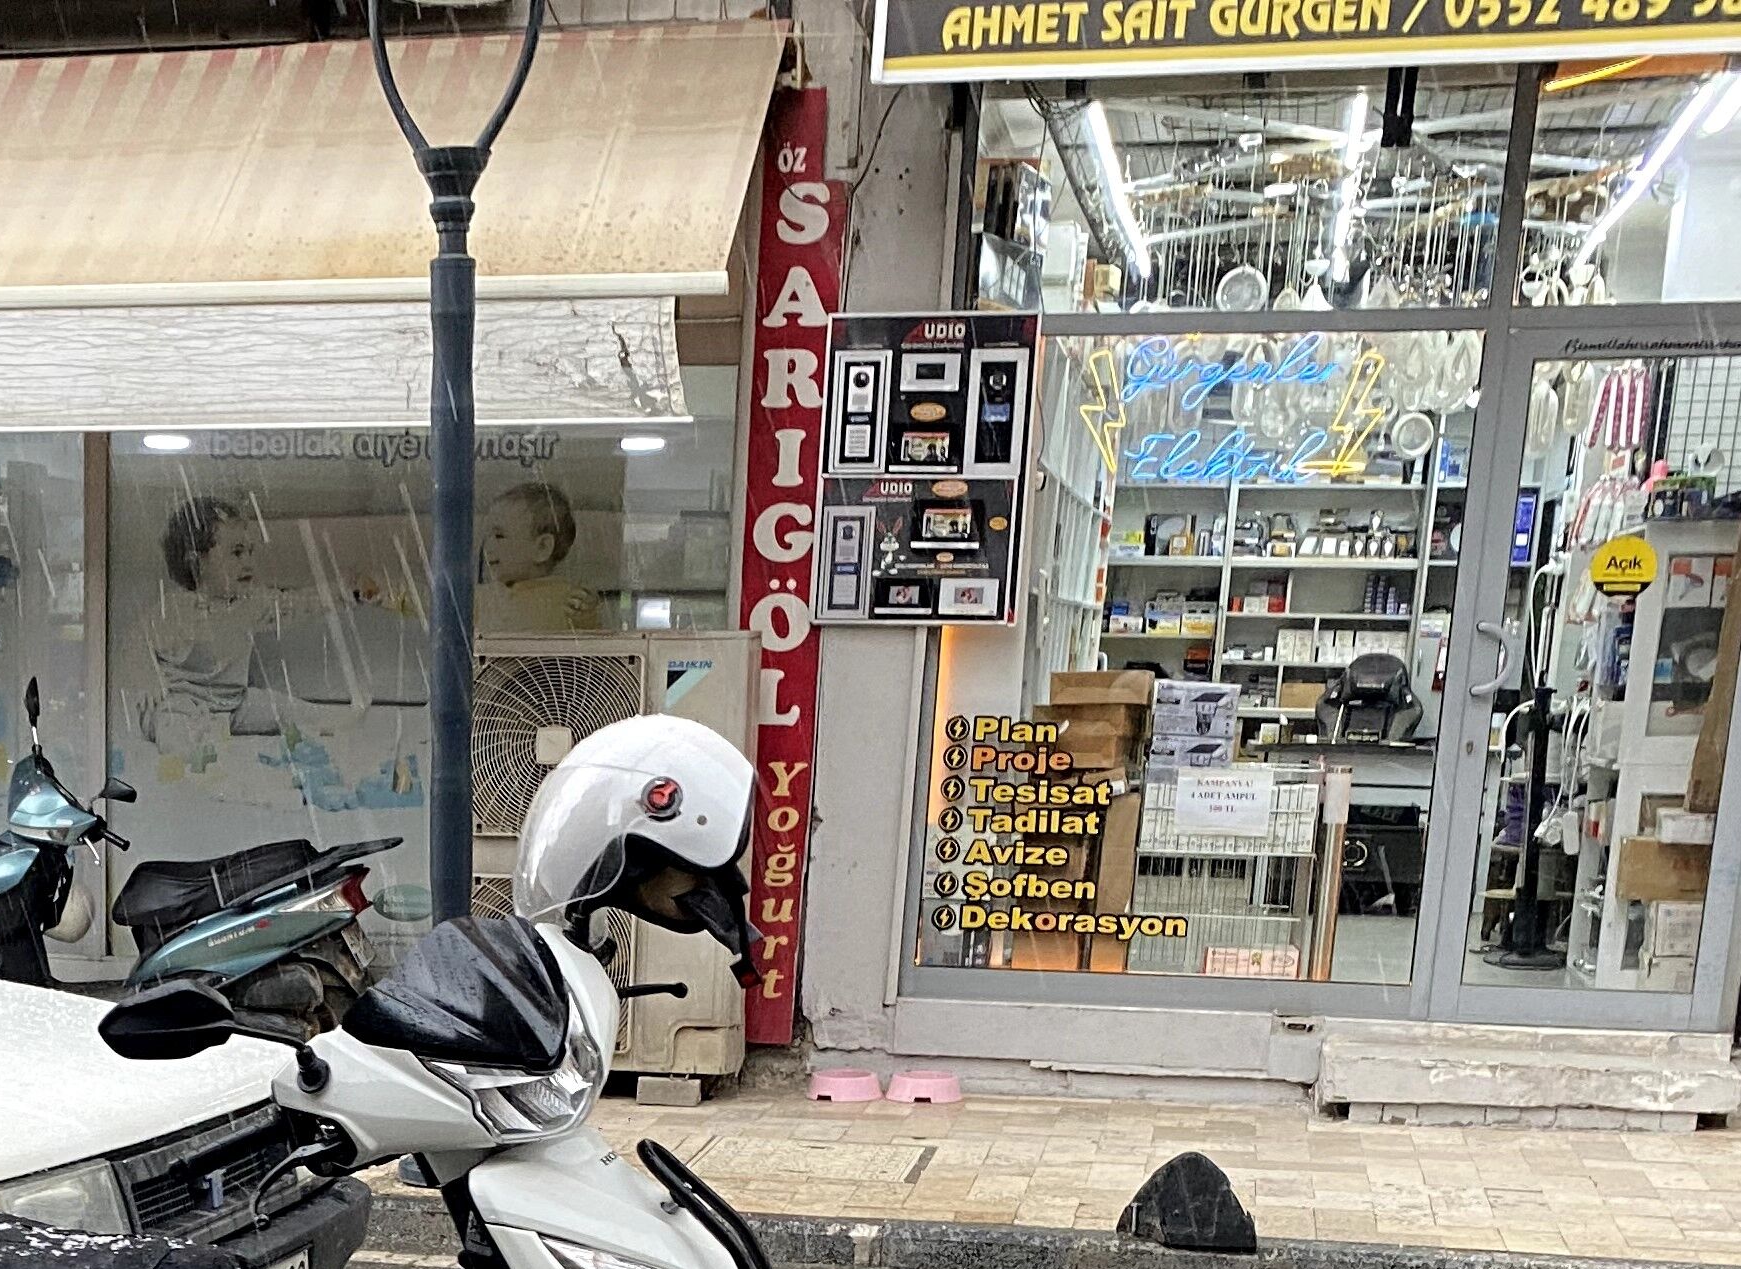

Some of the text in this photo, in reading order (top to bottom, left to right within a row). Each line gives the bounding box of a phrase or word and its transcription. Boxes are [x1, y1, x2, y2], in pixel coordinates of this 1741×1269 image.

[942, 1, 1089, 52] AHMET
[749, 142, 832, 999] ÖZ SARIGÖL Yoğurt
[1605, 554, 1643, 577] Açık
[667, 660, 713, 669] DAIKIN
[973, 716, 1058, 743] Plan
[971, 746, 1074, 774] Proje
[969, 778, 1111, 805] Tesisat
[967, 807, 1100, 835] Tadilat
[963, 840, 1069, 866] Avize
[963, 871, 1097, 901] Şofben
[960, 905, 1189, 939] Dekorasyon
